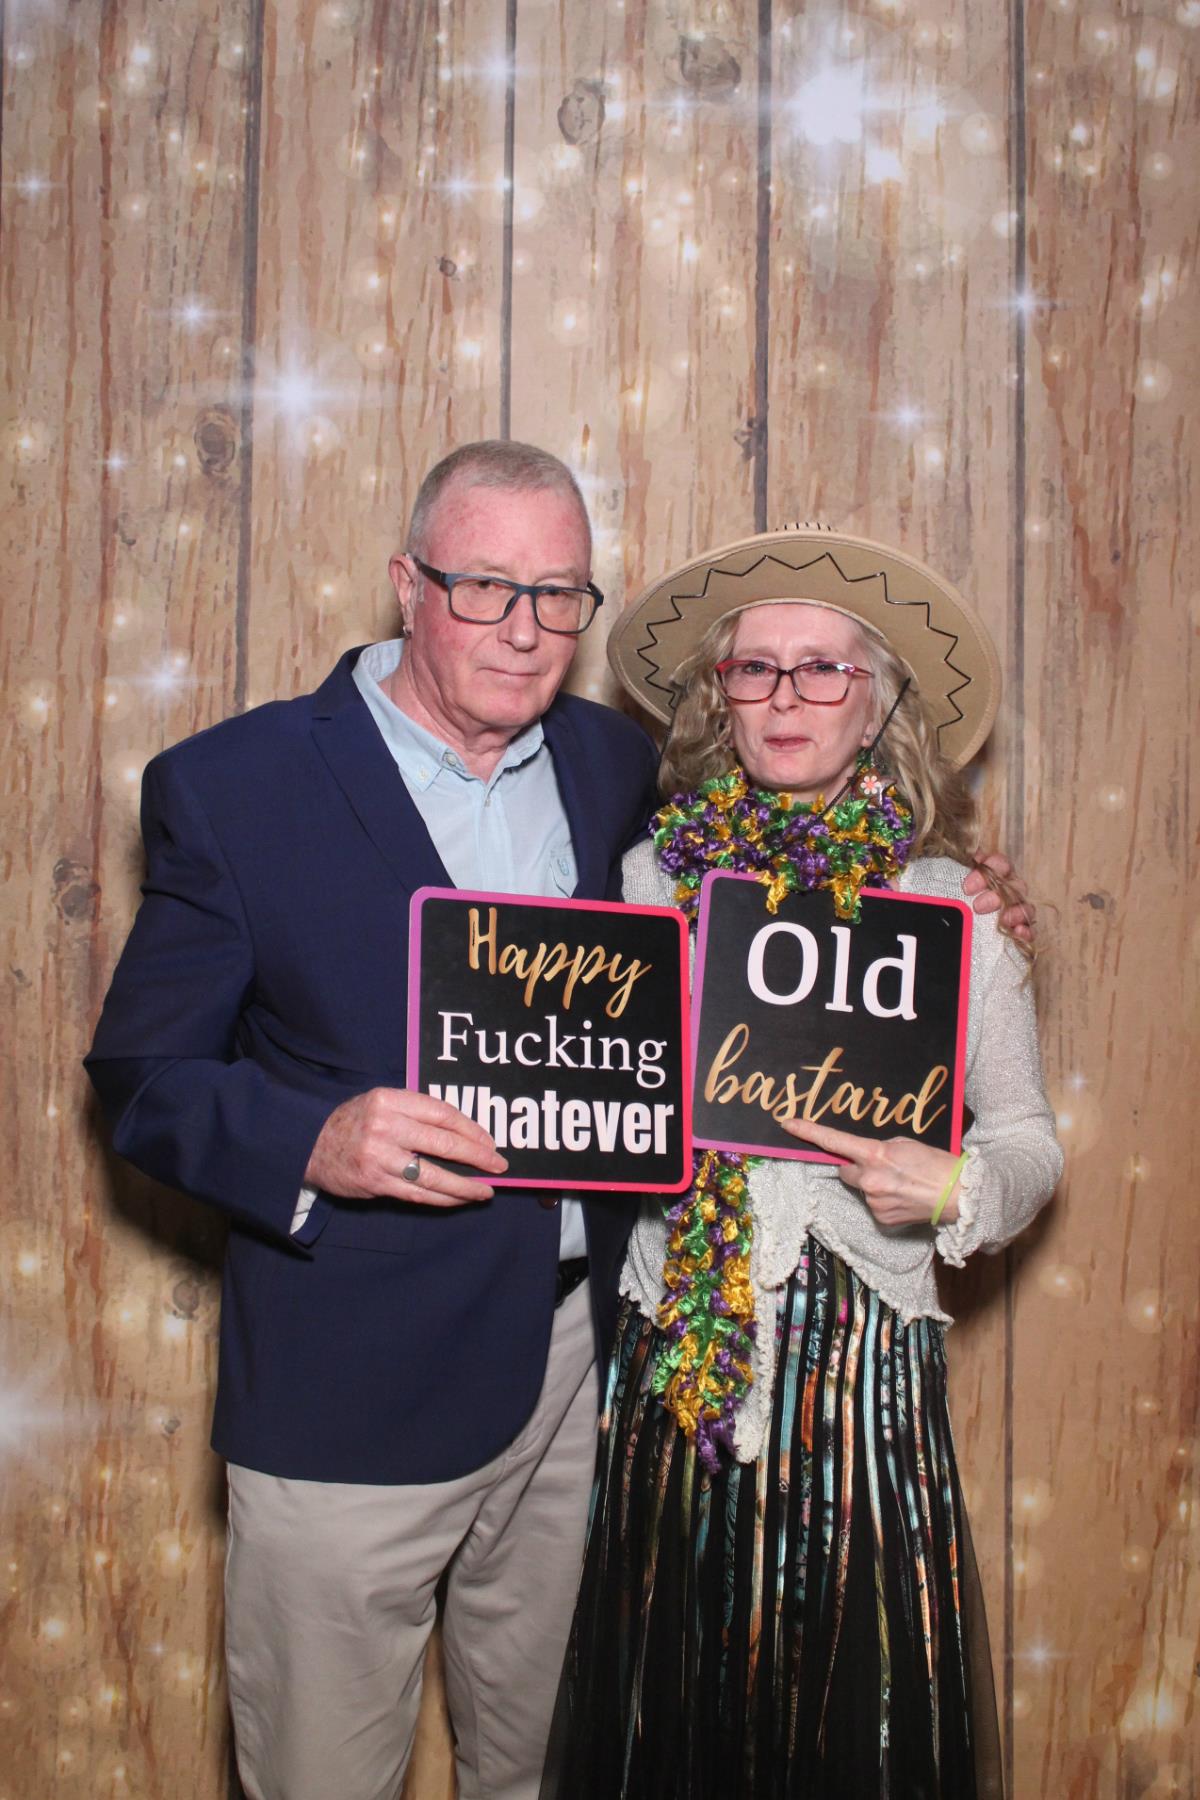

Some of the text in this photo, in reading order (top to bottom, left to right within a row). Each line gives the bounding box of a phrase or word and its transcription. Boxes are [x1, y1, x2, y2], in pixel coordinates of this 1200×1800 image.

[468, 906, 652, 1018] Happy
[747, 921, 917, 1021] Old
[437, 1010, 667, 1088] Fucking
[704, 1023, 949, 1134] bastard
